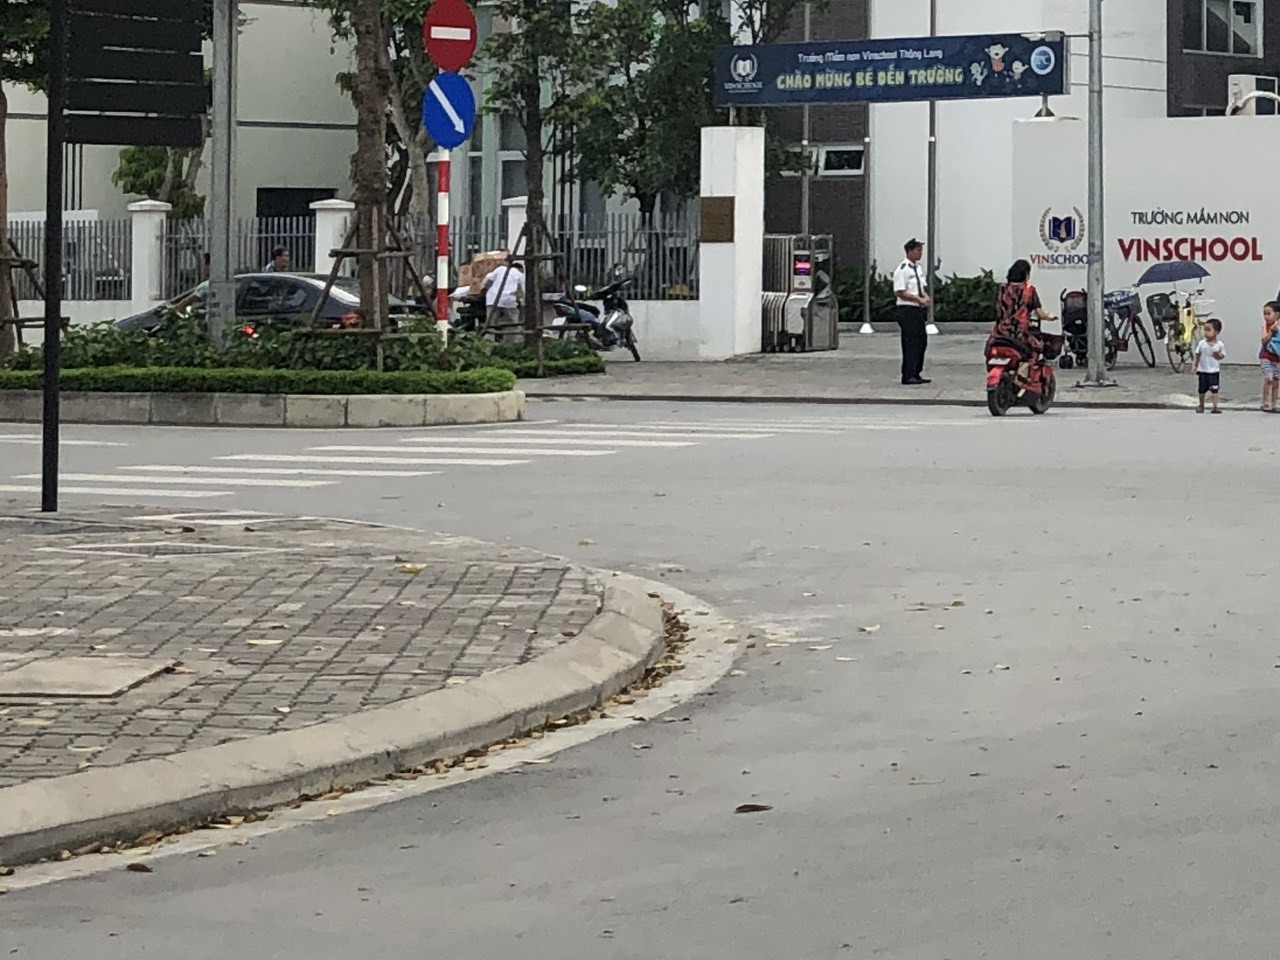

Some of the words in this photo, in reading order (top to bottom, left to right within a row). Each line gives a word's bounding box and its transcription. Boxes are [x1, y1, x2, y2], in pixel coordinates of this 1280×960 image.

[776, 68, 812, 89] CHÀO
[855, 65, 874, 86] BÉ
[1131, 206, 1184, 225] TRƯỜNG
[1219, 211, 1250, 224] NON
[1030, 253, 1090, 265] VINSCHOO
[1117, 237, 1263, 262] VINSCHOOL
